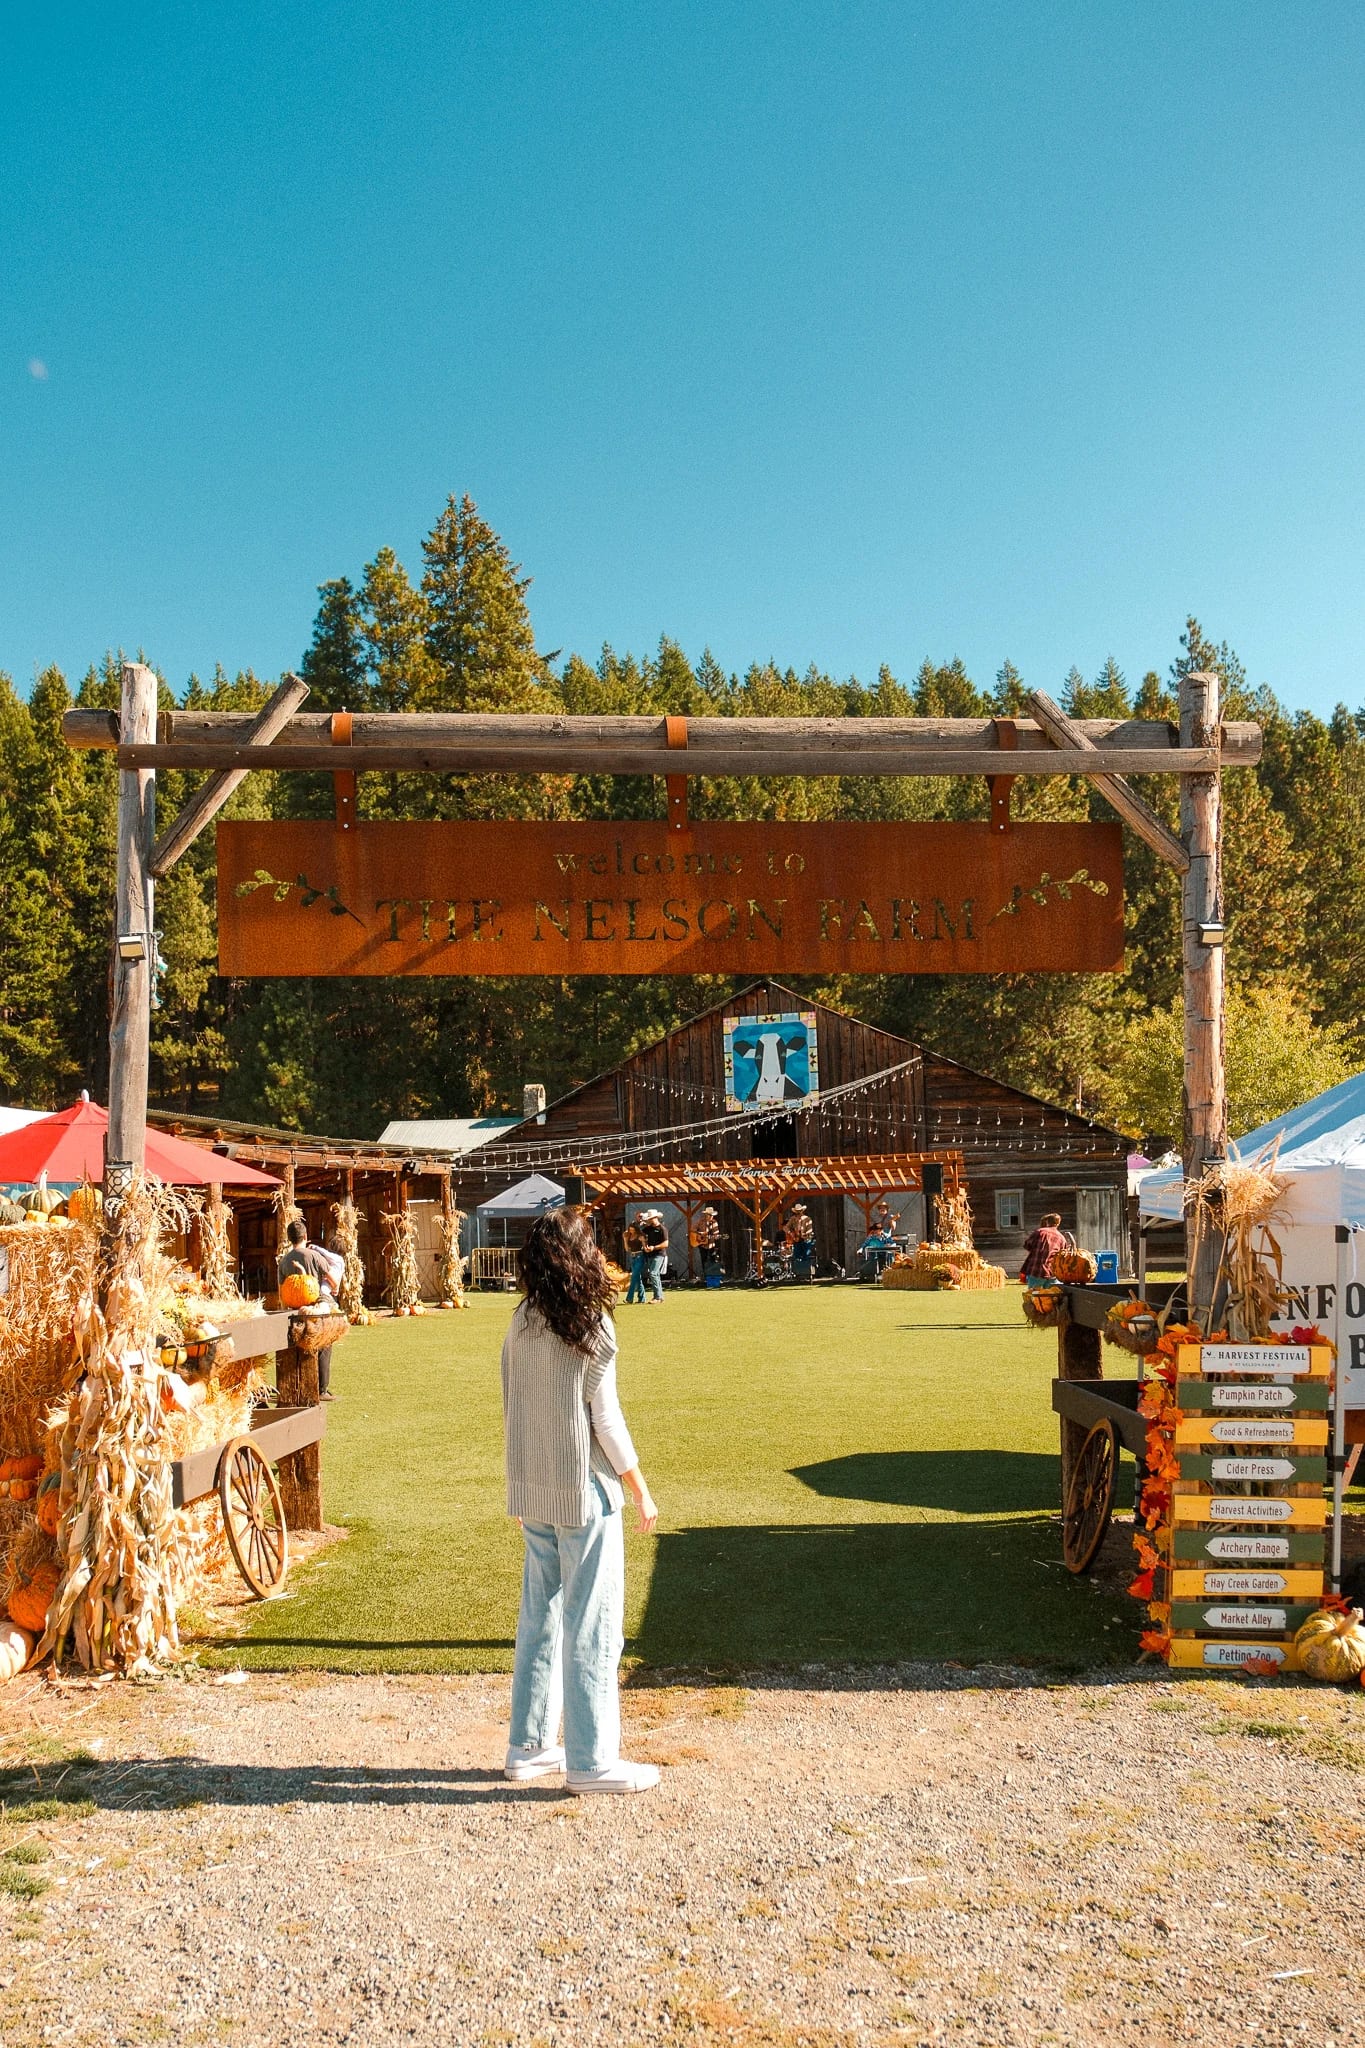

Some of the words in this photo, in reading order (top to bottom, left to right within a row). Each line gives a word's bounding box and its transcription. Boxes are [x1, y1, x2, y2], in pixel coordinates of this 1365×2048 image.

[553, 840, 743, 876] welcome
[767, 850, 807, 876] to
[374, 898, 504, 943] THE
[530, 898, 788, 943] NELSON
[816, 898, 979, 942] FARM
[738, 1165, 777, 1178] Harvest
[780, 1163, 823, 1176] Festival
[1218, 1351, 1261, 1360] HARVEST
[1263, 1352, 1307, 1361] FESTIVAL
[1219, 1389, 1256, 1403] Pumpkin
[1258, 1390, 1283, 1401] Patch
[1220, 1427, 1236, 1436] Food
[1237, 1428, 1242, 1436] &
[1244, 1427, 1289, 1437] Refreshments
[1226, 1463, 1249, 1475] Cider
[1251, 1464, 1274, 1475] Press
[1215, 1504, 1245, 1515] Harvest
[1246, 1506, 1283, 1516] Activities
[1220, 1542, 1253, 1556] Archery
[1255, 1542, 1281, 1556] Range
[1210, 1578, 1226, 1591] Hay
[1227, 1578, 1250, 1589] Creek
[1252, 1579, 1279, 1589] Garden
[1220, 1612, 1249, 1625] Market
[1251, 1613, 1273, 1628] Alley
